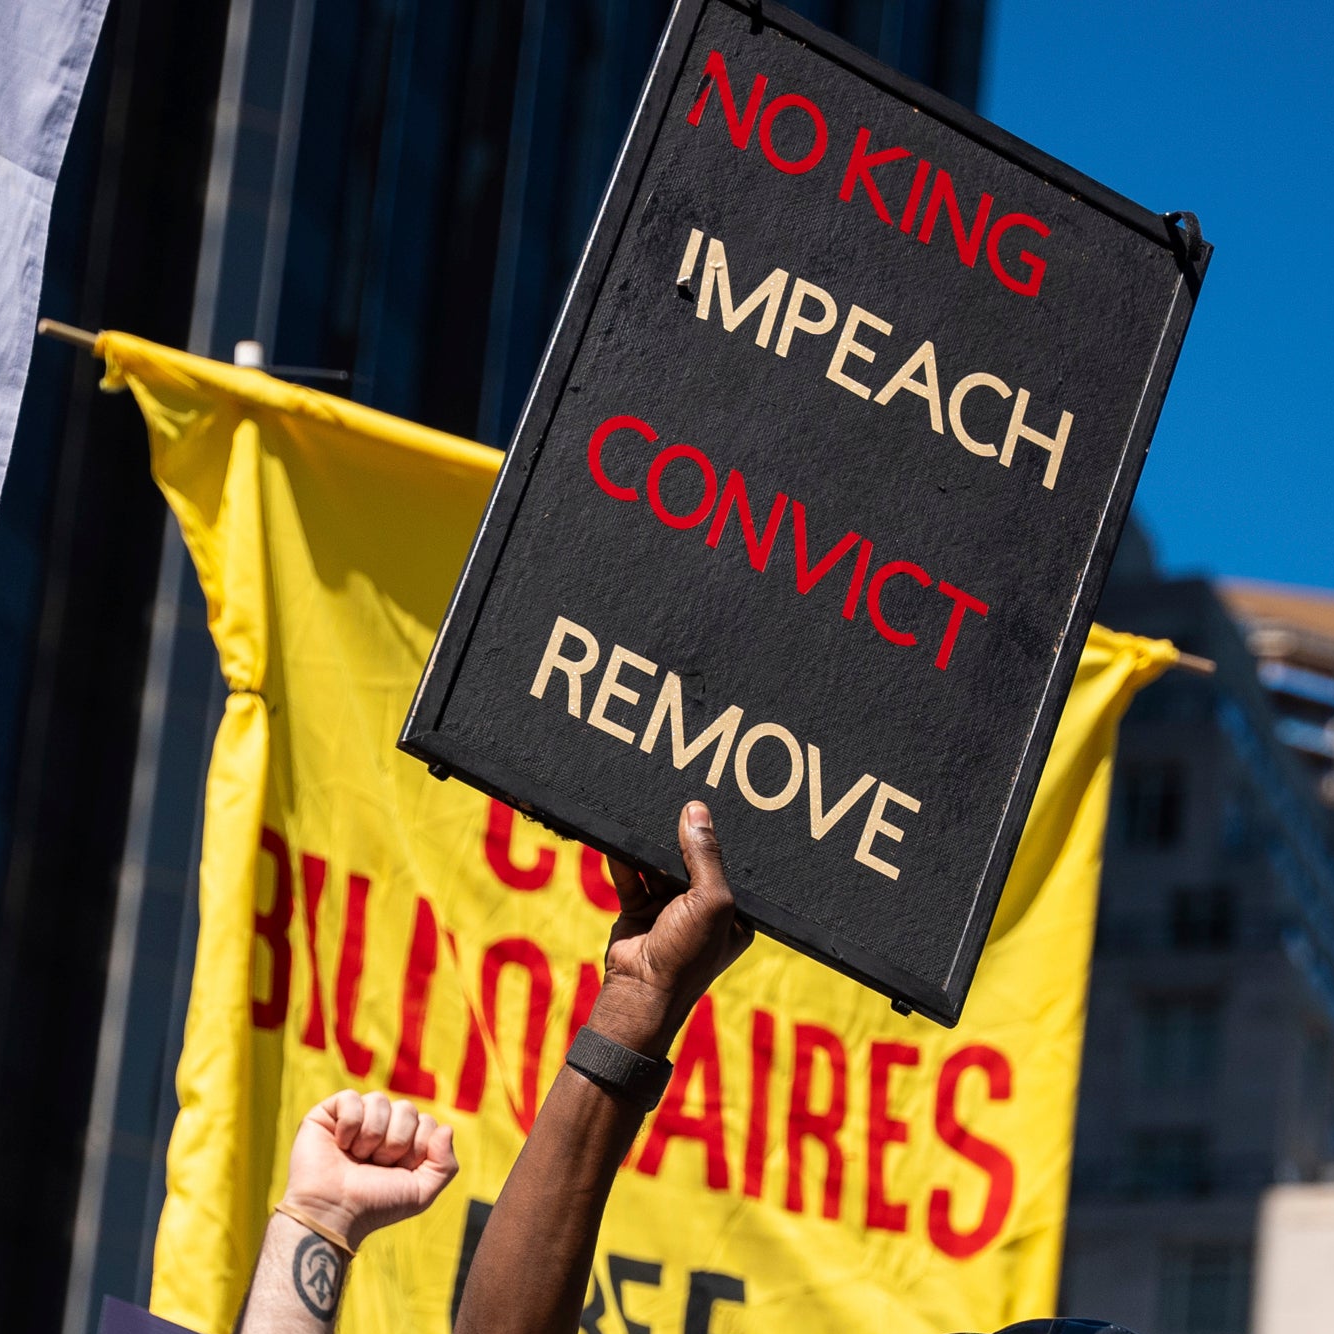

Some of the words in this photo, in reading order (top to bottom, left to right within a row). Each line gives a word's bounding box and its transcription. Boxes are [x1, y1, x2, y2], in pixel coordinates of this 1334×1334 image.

[687, 50, 829, 176] NO
[838, 126, 1051, 298] KING
[676, 227, 1075, 491] IMPEACH
[587, 413, 990, 671] CONVICT
[529, 614, 923, 882] REMOVE
